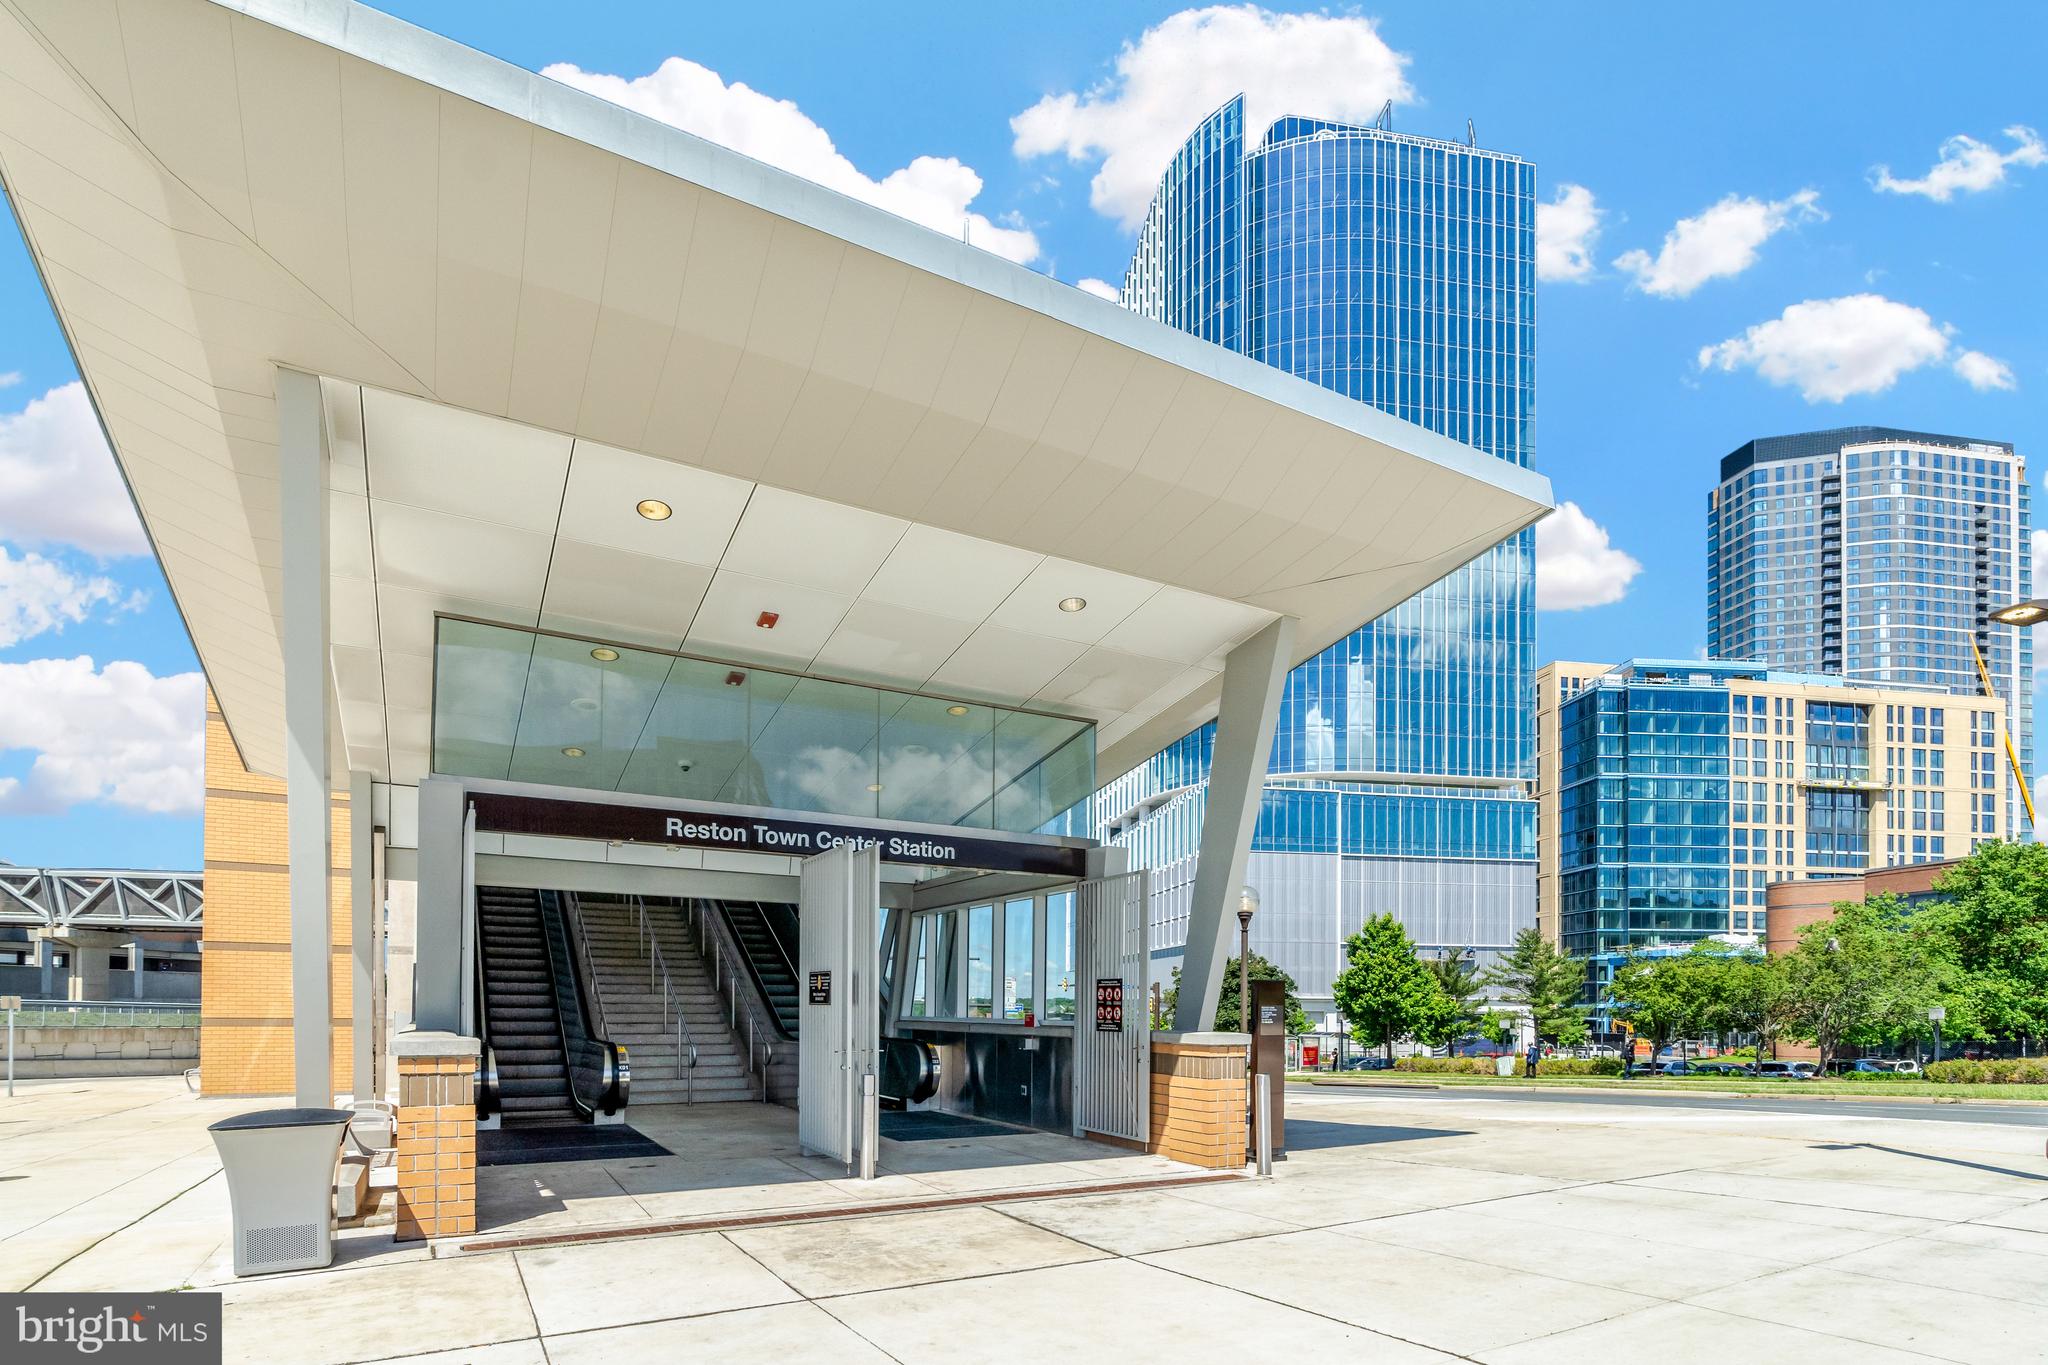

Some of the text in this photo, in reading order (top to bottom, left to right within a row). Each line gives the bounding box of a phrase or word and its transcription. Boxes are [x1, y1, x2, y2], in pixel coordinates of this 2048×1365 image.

[666, 817, 746, 842] Reston
[753, 824, 810, 847] Town
[889, 837, 955, 860] Station
